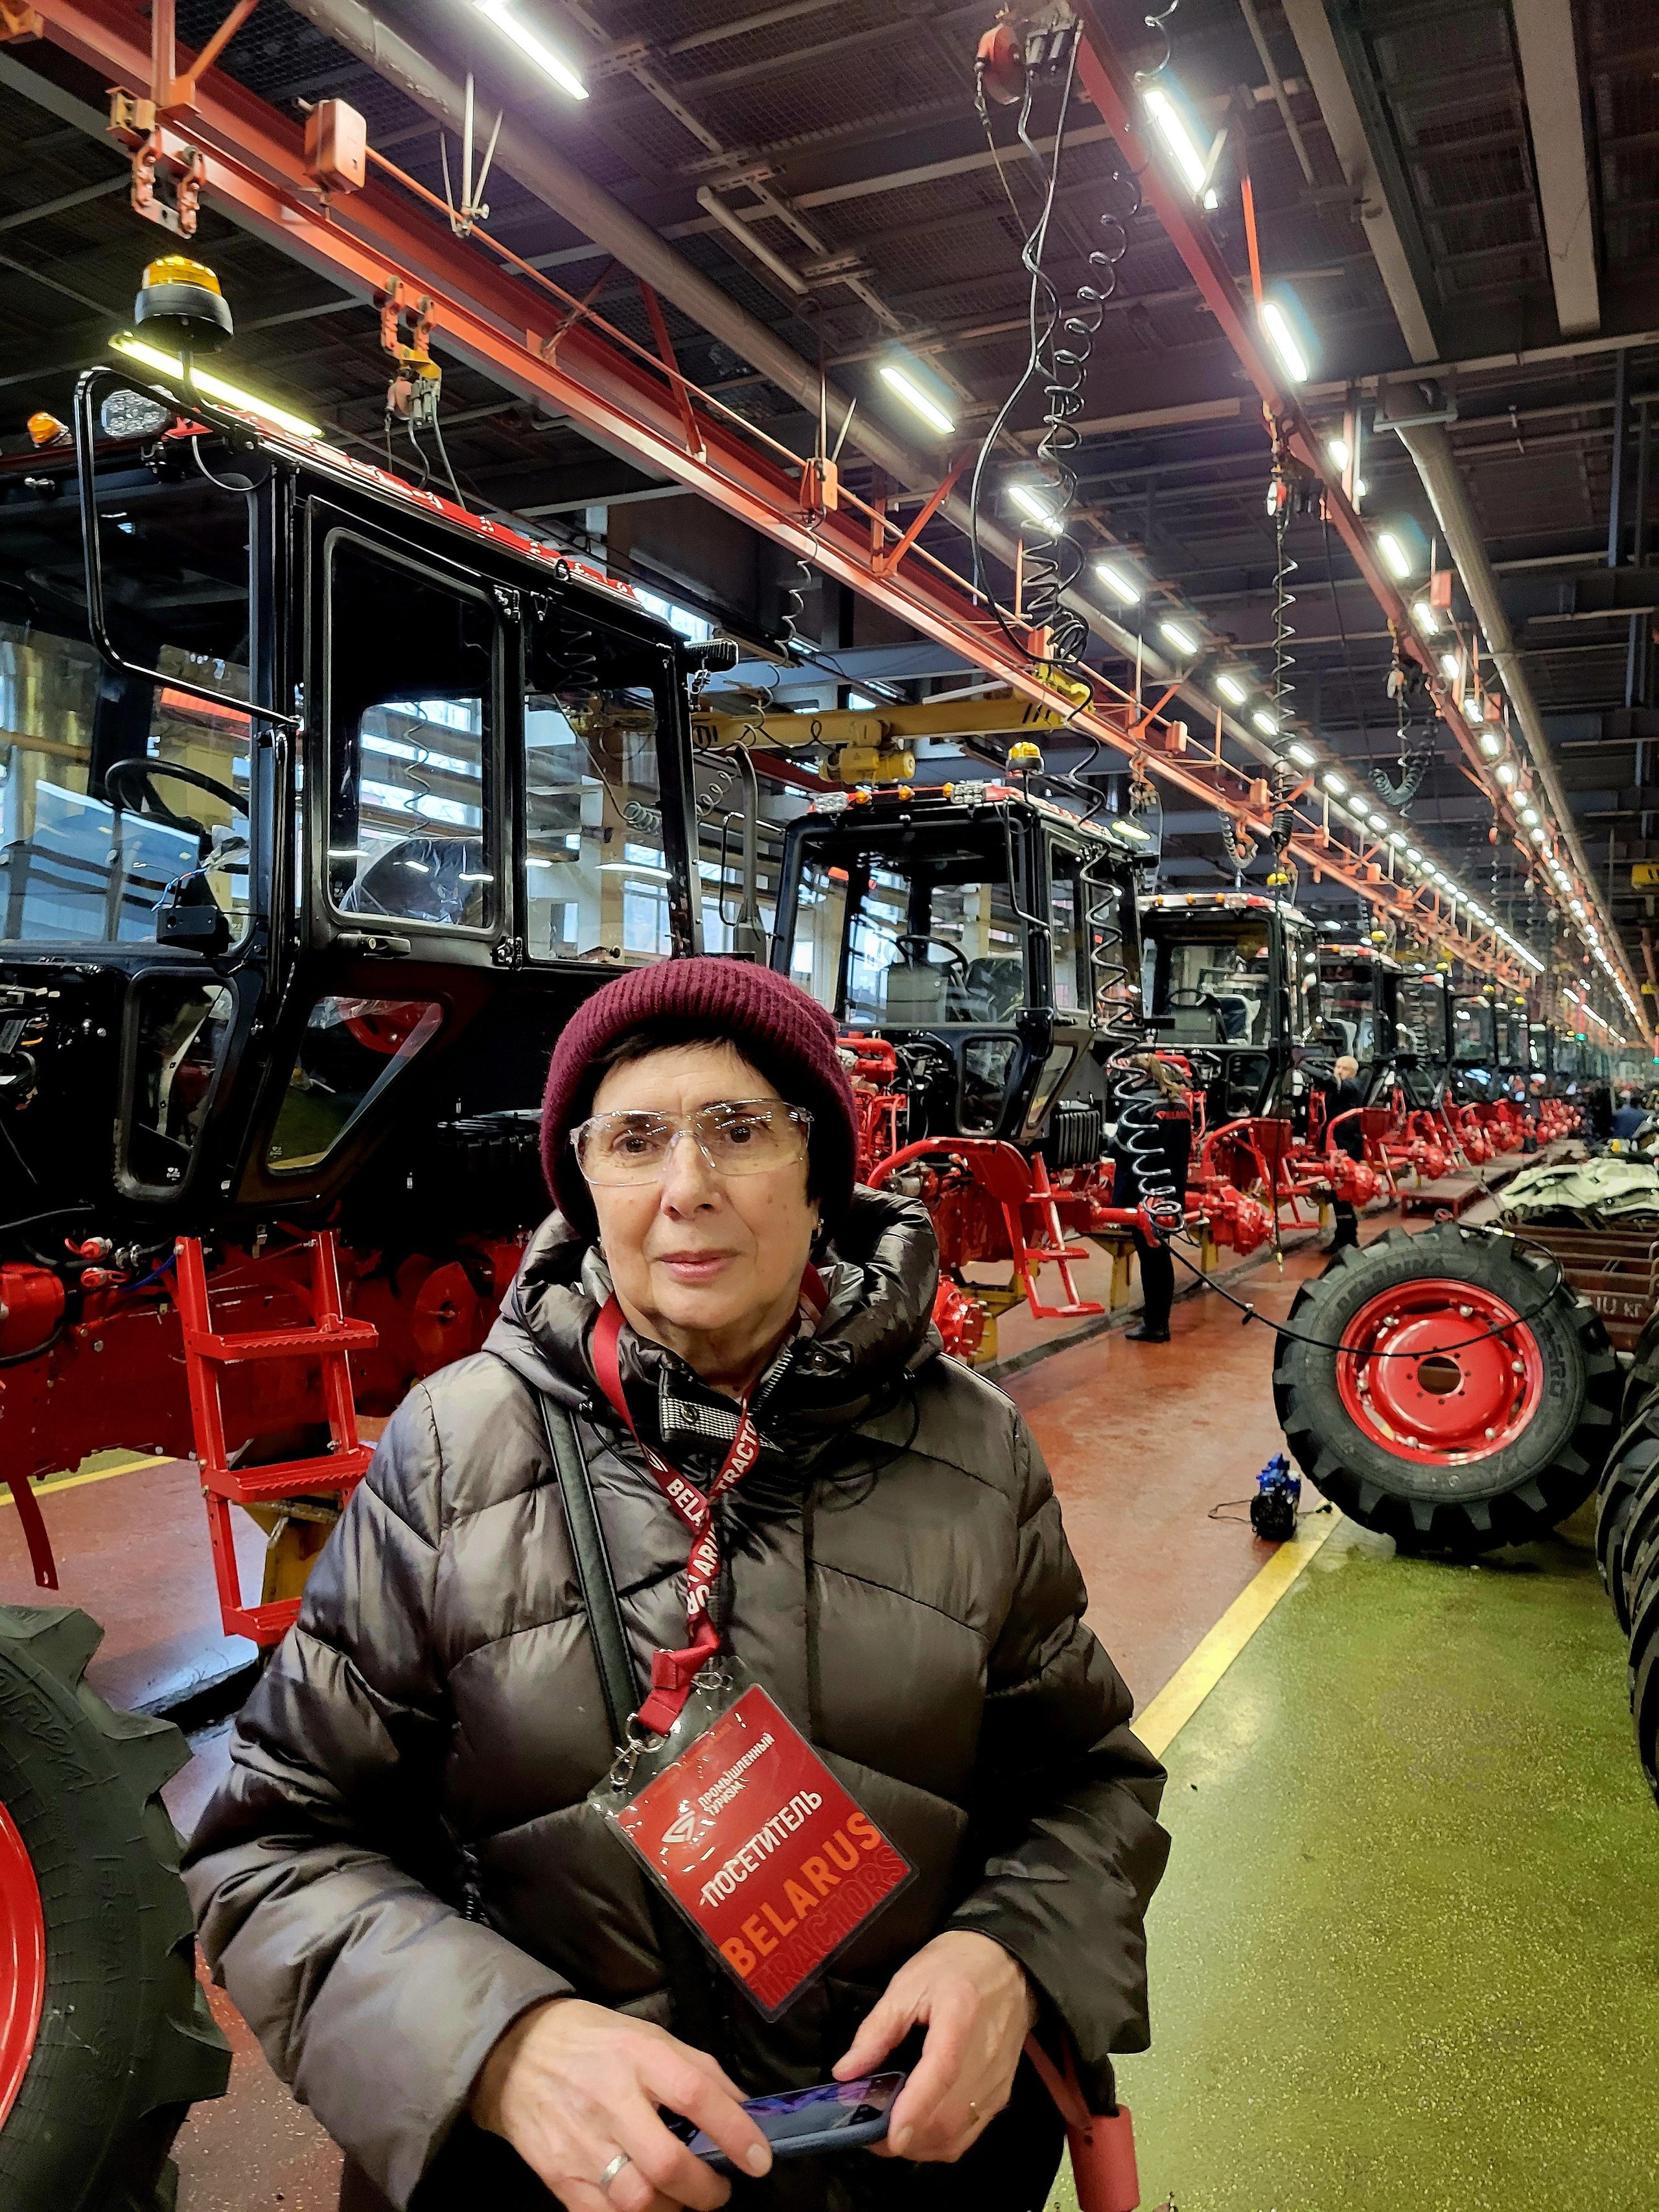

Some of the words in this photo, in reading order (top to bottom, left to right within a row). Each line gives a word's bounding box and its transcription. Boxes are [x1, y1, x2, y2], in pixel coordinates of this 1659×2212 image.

[698, 1732, 775, 1806] ПРОМЫШЛЕННЫЙ
[701, 1790, 822, 1907] ПОСЕТИТЕЛЬ
[719, 1812, 881, 1979] BELARUS
